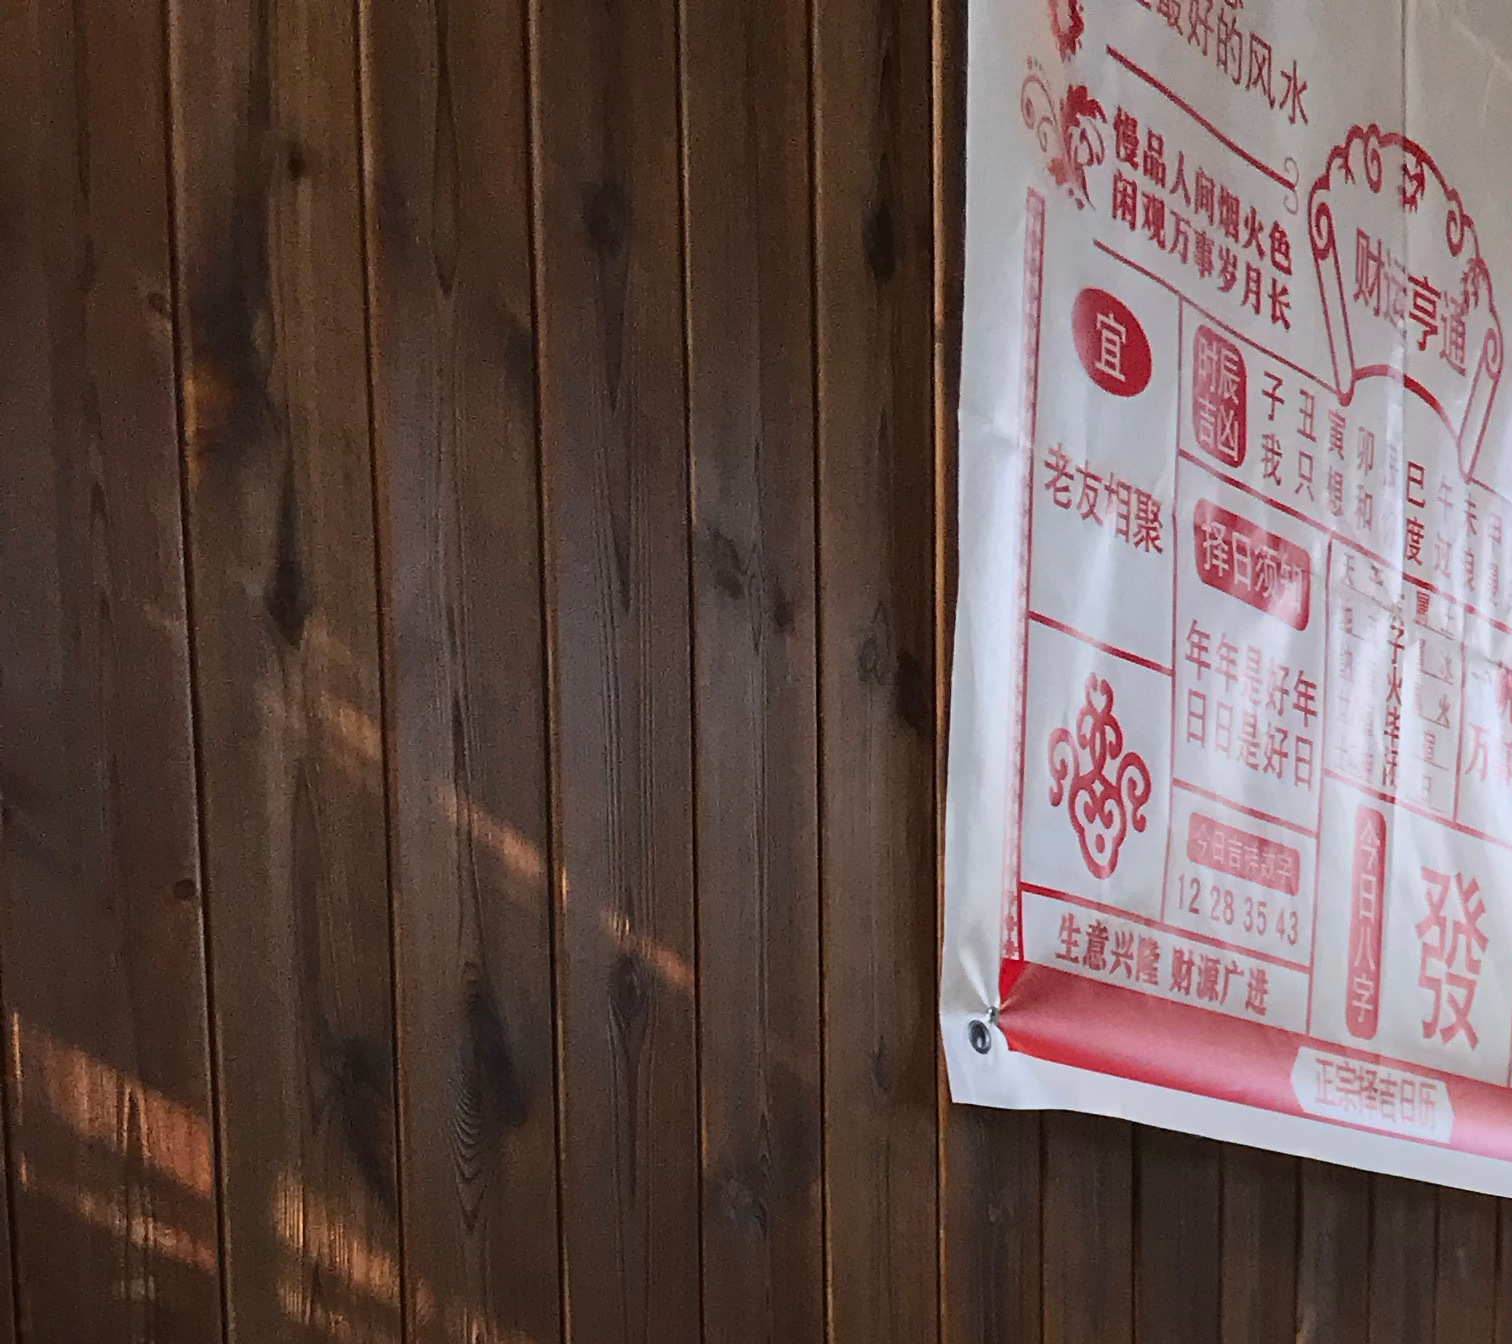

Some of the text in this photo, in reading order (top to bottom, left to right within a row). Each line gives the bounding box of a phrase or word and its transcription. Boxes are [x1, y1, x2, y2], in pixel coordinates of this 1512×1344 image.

[1136, 0, 1308, 124] 最好的风水
[1112, 105, 1293, 276] 慢品人间烟火色
[1110, 168, 1291, 331] 闲观万事岁月长
[1352, 227, 1468, 377] 财运亨通
[1095, 311, 1128, 383] 宜
[1043, 442, 1164, 556] 老友相聚
[1184, 618, 1318, 729] 年年是好年
[1185, 687, 1315, 790] 日日是好日
[1055, 911, 1269, 1016] 生意兴隆 财源广进
[1176, 872, 1299, 949] 12 28 35 43
[1352, 820, 1381, 1024] 今日八字
[1314, 1056, 1437, 1132] 正宗择吉日历
